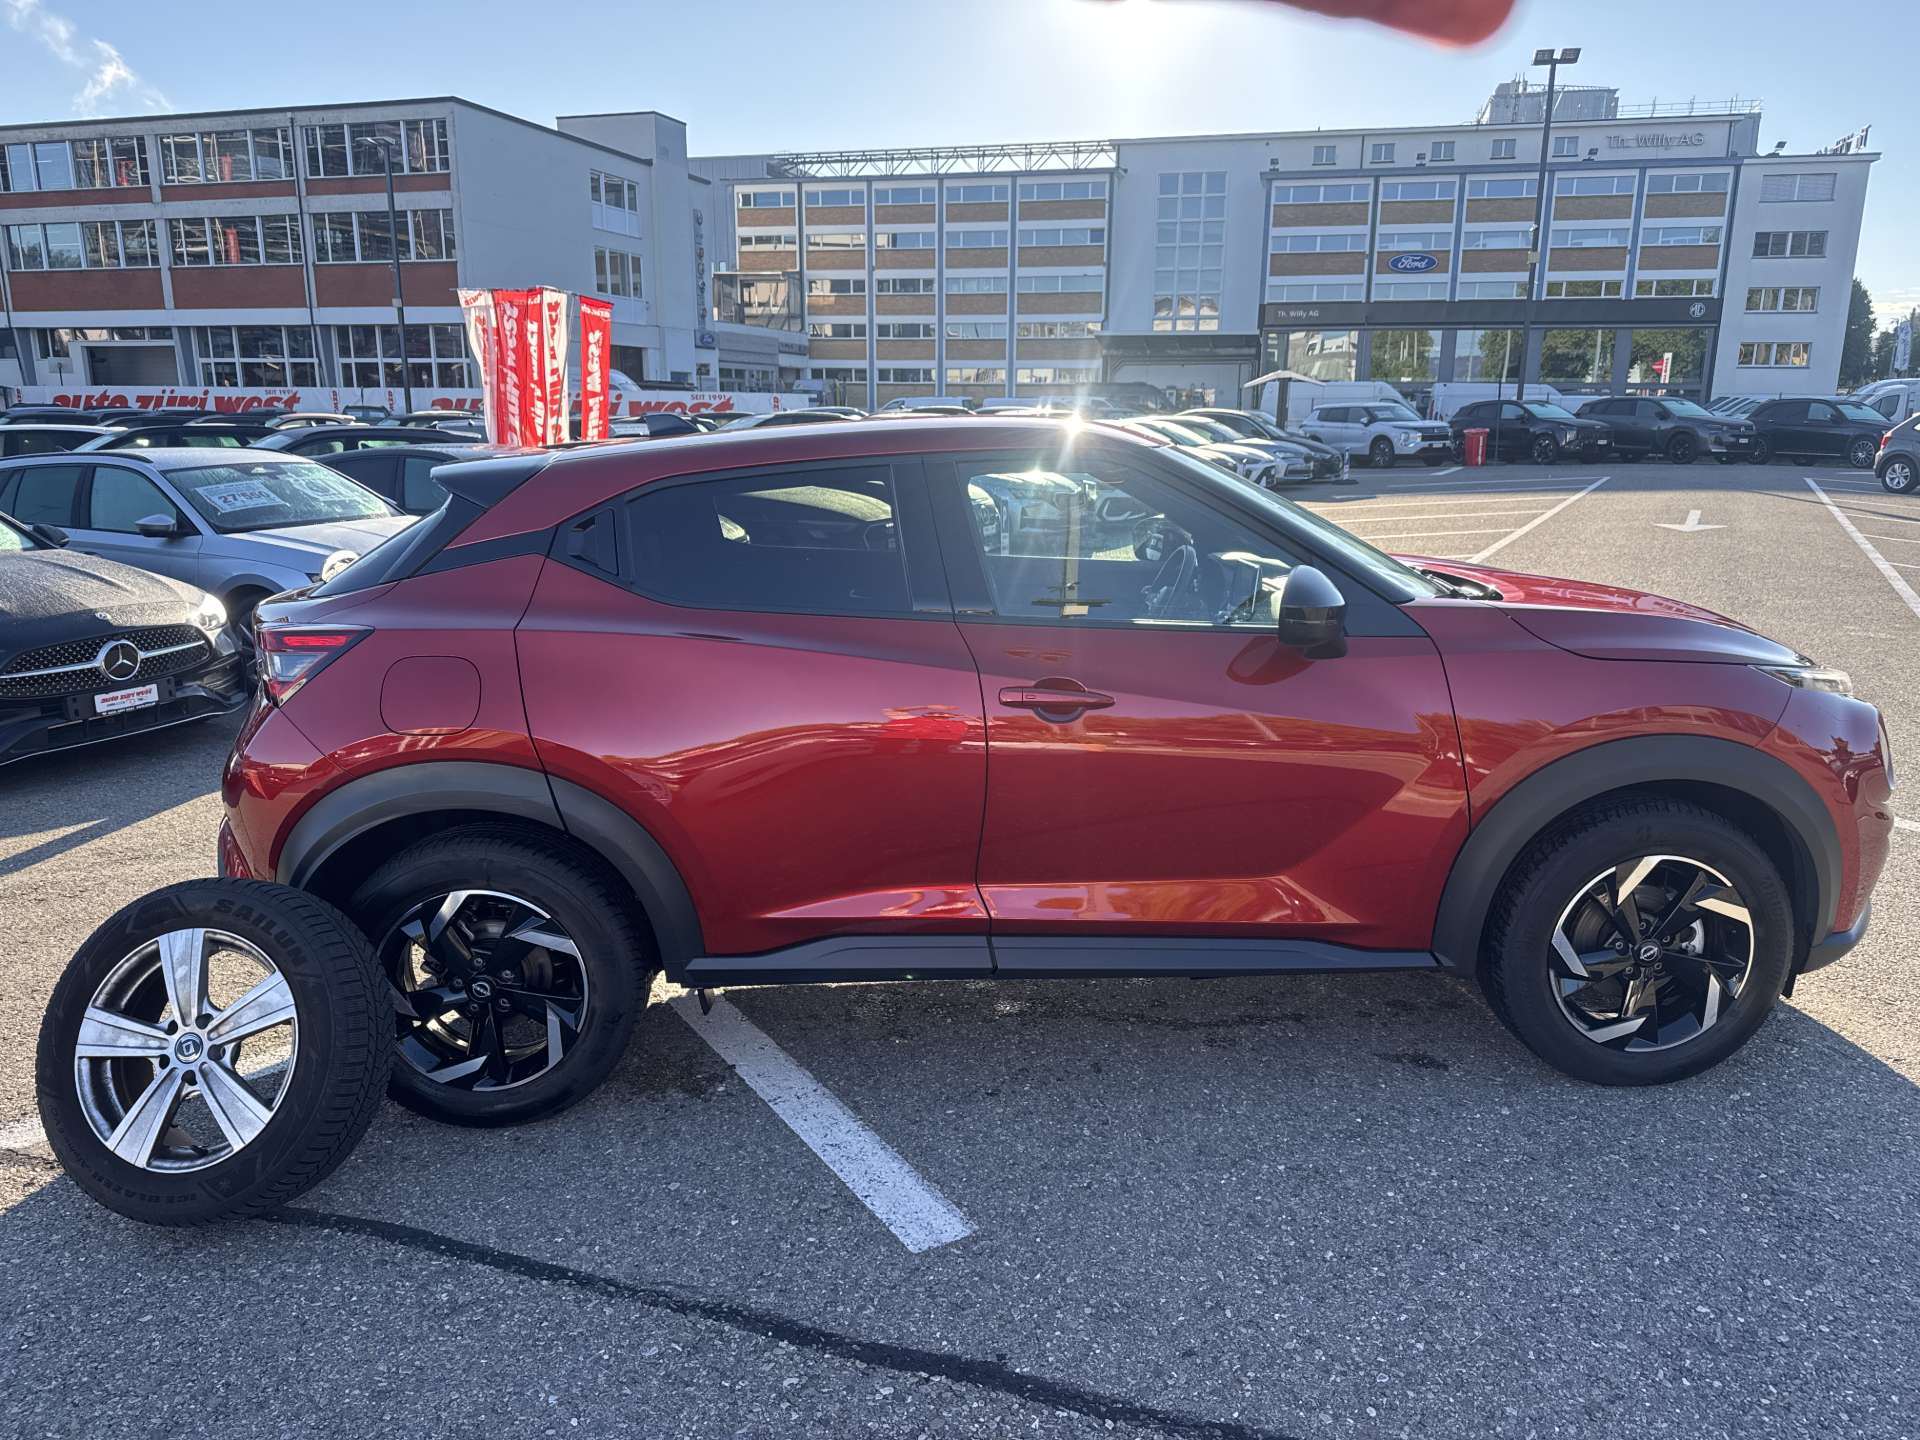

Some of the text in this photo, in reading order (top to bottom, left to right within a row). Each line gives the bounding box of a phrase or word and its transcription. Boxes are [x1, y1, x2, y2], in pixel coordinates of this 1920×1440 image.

[1637, 133, 1673, 151] Willy
[1679, 132, 1705, 147] AG
[1398, 255, 1428, 269] Ford
[1290, 310, 1307, 318] Willy
[53, 389, 301, 414] auto züri west
[628, 395, 735, 416] west
[213, 898, 307, 966] SAILUN
